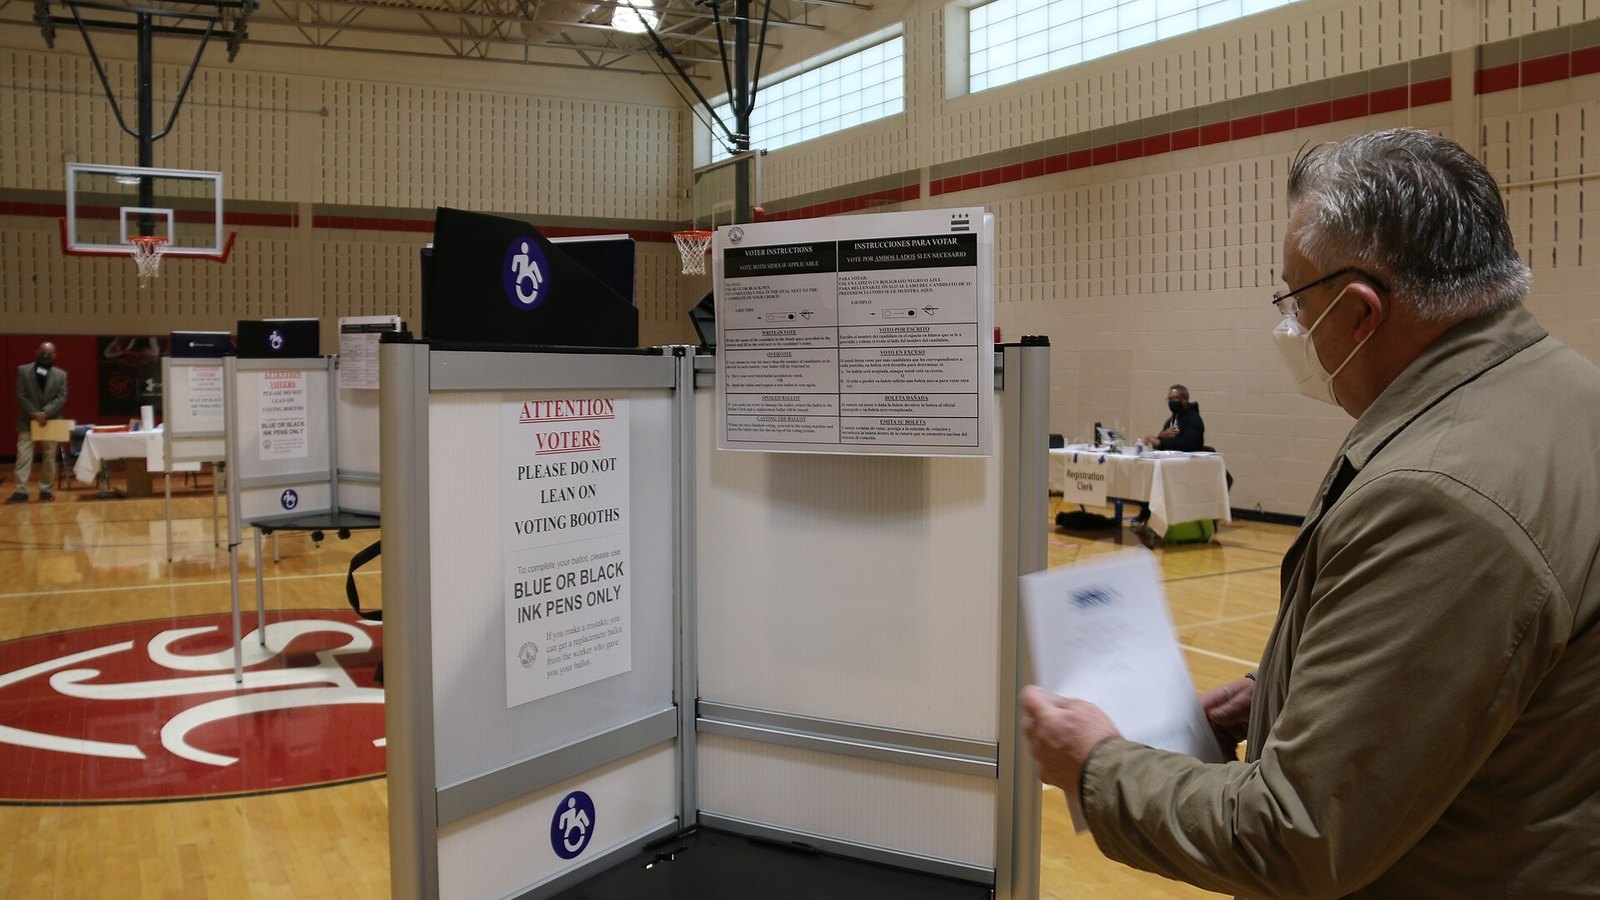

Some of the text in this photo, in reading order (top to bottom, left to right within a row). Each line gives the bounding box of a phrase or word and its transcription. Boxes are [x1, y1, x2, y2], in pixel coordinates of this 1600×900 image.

[744, 245, 813, 256] VOTER INSTRUCTIONS
[854, 237, 958, 250] INSTRUCCIONES PARA VOTAR
[788, 260, 819, 268] APPLICABLE
[932, 251, 966, 259] NECESARIO
[519, 398, 615, 420] ATTENTION
[535, 429, 601, 450] VOTERS
[517, 457, 617, 481] PLEASE DO NOT
[1066, 468, 1104, 481] Registration
[541, 484, 597, 504] LEAN ON
[1077, 481, 1093, 491] Clerk
[514, 507, 620, 535] VOTING BOOTHS
[518, 566, 527, 575] To
[528, 561, 556, 573] complete
[556, 559, 570, 570] your
[571, 554, 589, 566] ballot,
[590, 551, 610, 563] please
[514, 561, 624, 599] BLUE OR BLACK
[517, 585, 622, 624] INK PENS ONLY
[546, 631, 553, 641] If
[552, 630, 565, 641] you
[564, 624, 581, 636] make
[581, 624, 586, 632] a
[609, 615, 621, 626] you
[546, 625, 623, 653] can get a replacement ballot
[546, 639, 620, 666] from the worker who gave
[546, 658, 592, 679] you your ballot.
